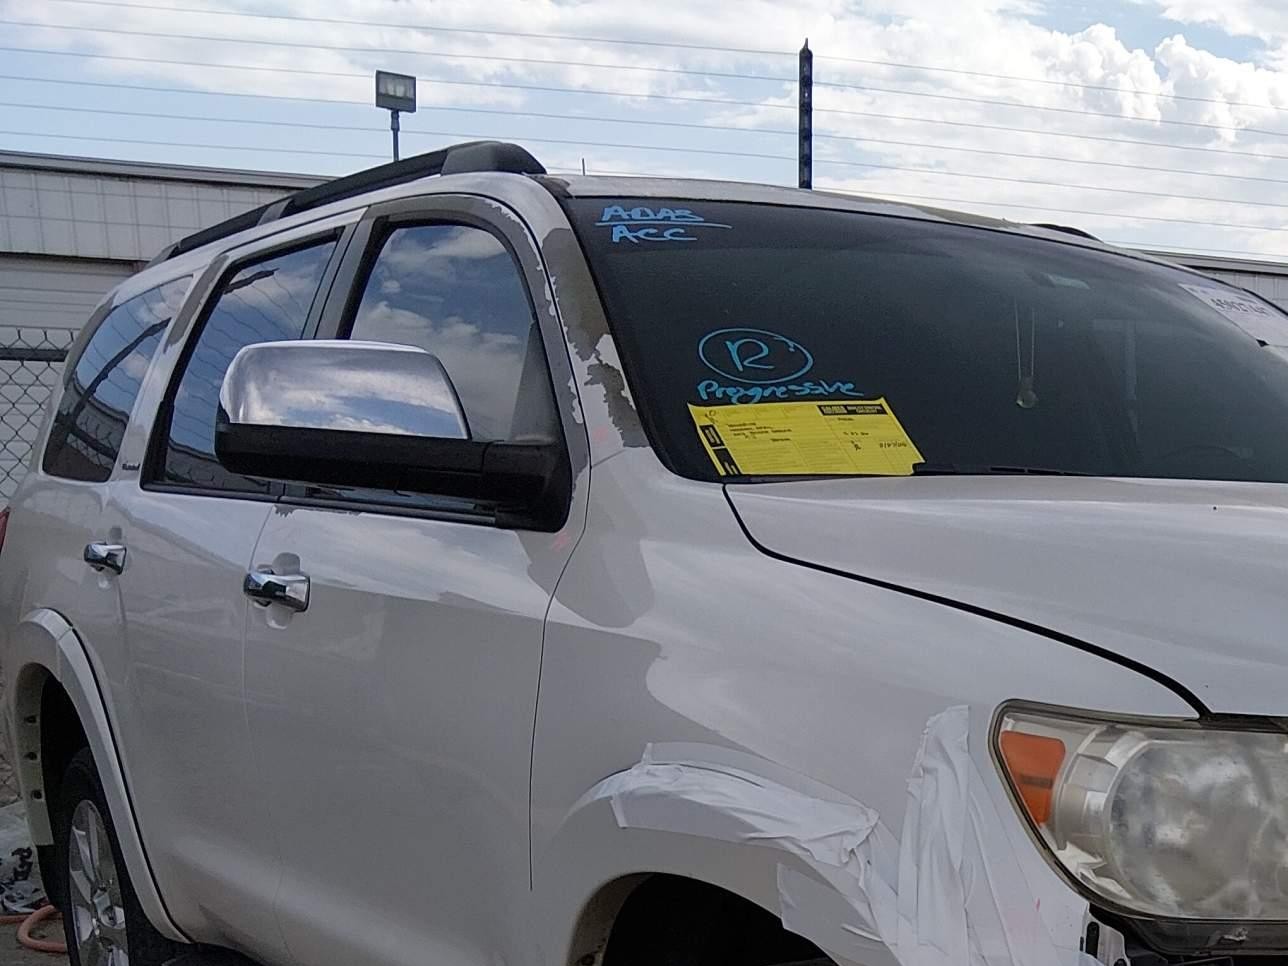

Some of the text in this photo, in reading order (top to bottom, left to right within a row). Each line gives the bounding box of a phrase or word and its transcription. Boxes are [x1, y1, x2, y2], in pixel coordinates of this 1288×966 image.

[601, 205, 704, 222] ADAS
[612, 224, 698, 243] ACC
[725, 338, 775, 372] R
[697, 379, 864, 405] Progressive
